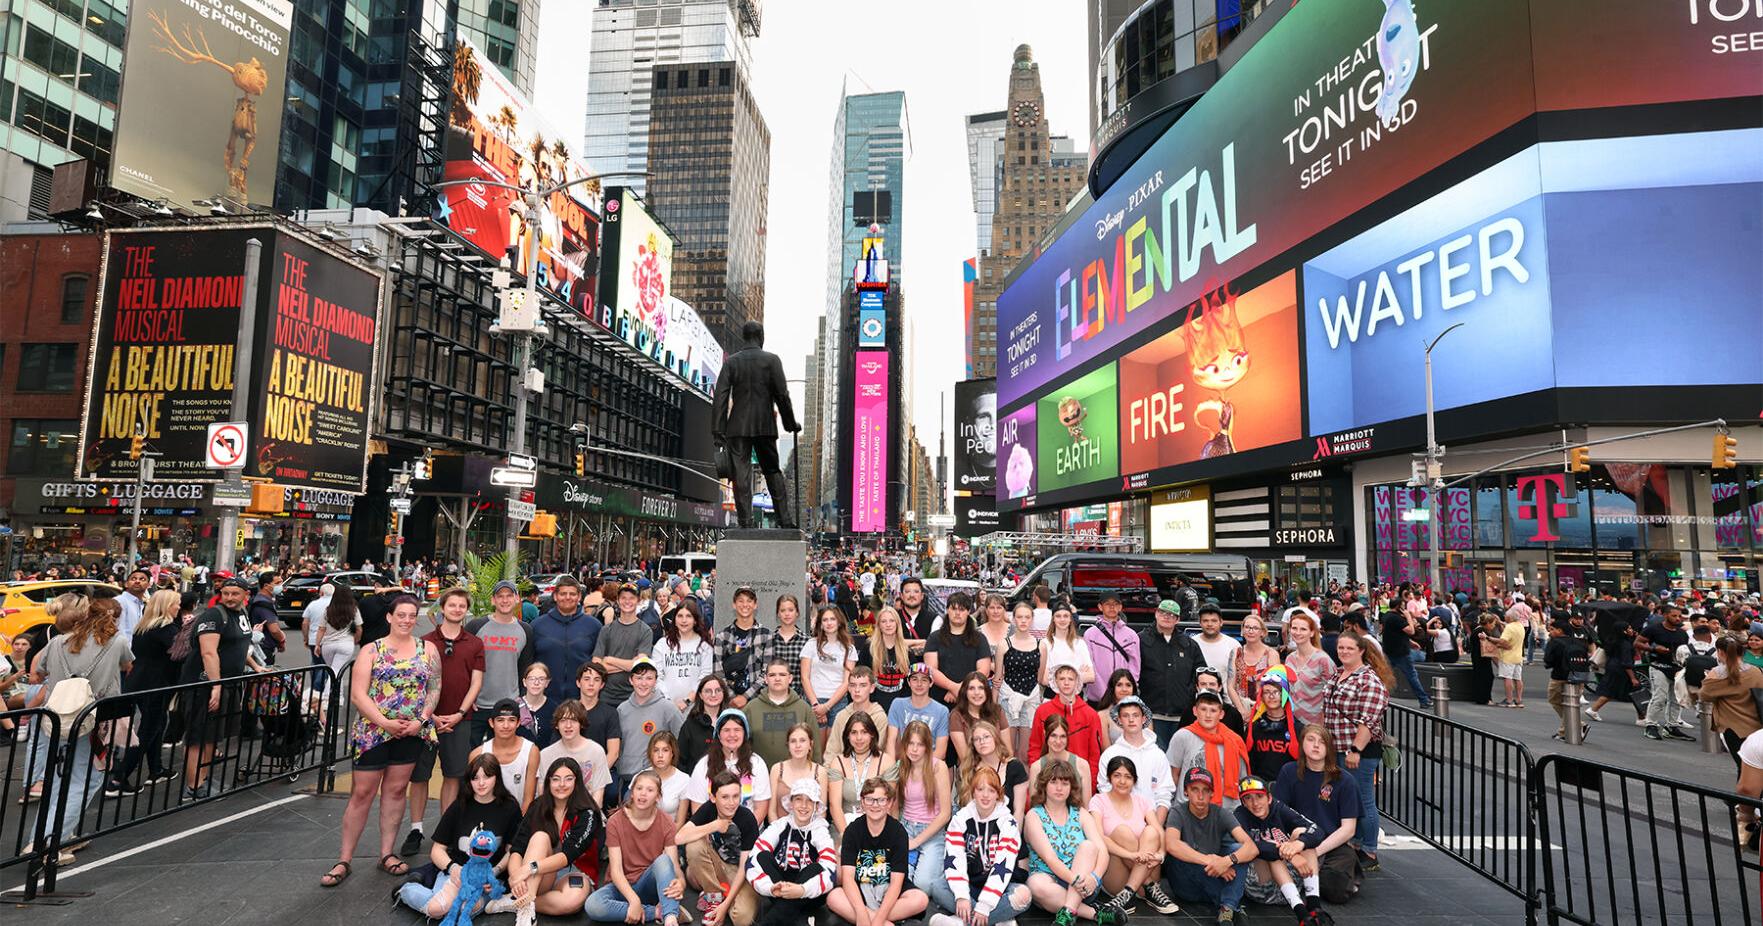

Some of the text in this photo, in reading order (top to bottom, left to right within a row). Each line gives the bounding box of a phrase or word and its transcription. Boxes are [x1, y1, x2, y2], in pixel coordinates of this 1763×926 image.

[223, 4, 246, 24] del
[248, 16, 282, 45] Toro:
[266, 2, 285, 17] view
[211, 9, 279, 56] Pinocchio
[1711, 32, 1763, 54] SEE
[1294, 31, 1381, 117] IN THEAT
[1282, 23, 1438, 166] TONIGT
[470, 114, 515, 178] THE
[1300, 153, 1332, 190] SEE
[1337, 138, 1354, 166] IT
[1360, 120, 1381, 152] IN
[120, 165, 154, 182] CHANEL
[606, 214, 618, 222] LG
[1095, 212, 1125, 241] Disney
[1128, 170, 1164, 213] PIXAR
[124, 246, 156, 278] THE
[1055, 141, 1257, 362] ELEMENTAL
[283, 252, 309, 291] THE
[1318, 217, 1530, 350] WATER
[118, 277, 162, 310] NEIL
[113, 310, 186, 342] MUSICAL
[277, 282, 375, 345] NEIL DIAMOND
[274, 317, 331, 360] MUSICAL
[1007, 324, 1041, 364] TONIGHT
[105, 345, 235, 392] A BEAUTIFUL
[267, 349, 364, 413] A BEAUTIFUL
[1011, 364, 1019, 378] SEE
[1024, 358, 1030, 369] IN
[100, 393, 165, 439] NOISE
[264, 392, 316, 445] NOISE
[1130, 384, 1185, 445] FIRE
[1002, 418, 1018, 447] AIR
[1333, 428, 1375, 443] MARRIOTT
[1333, 440, 1370, 453] MARQUIS
[178, 460, 208, 468] THEAT
[1056, 436, 1102, 476] EARTH
[41, 482, 203, 499] GIFTS LUGGAGE
[873, 471, 880, 480] OF
[1290, 469, 1322, 480] SEPHORA
[301, 489, 355, 507] LUGGAGE
[562, 480, 603, 509] Disney store
[641, 496, 670, 517] FOREVER
[669, 502, 678, 518] 21
[1376, 490, 1407, 506] WE
[315, 512, 335, 520] SONY
[1378, 524, 1408, 539] WE
[1276, 529, 1335, 544] SEPHORA
[1257, 739, 1291, 753] NASA
